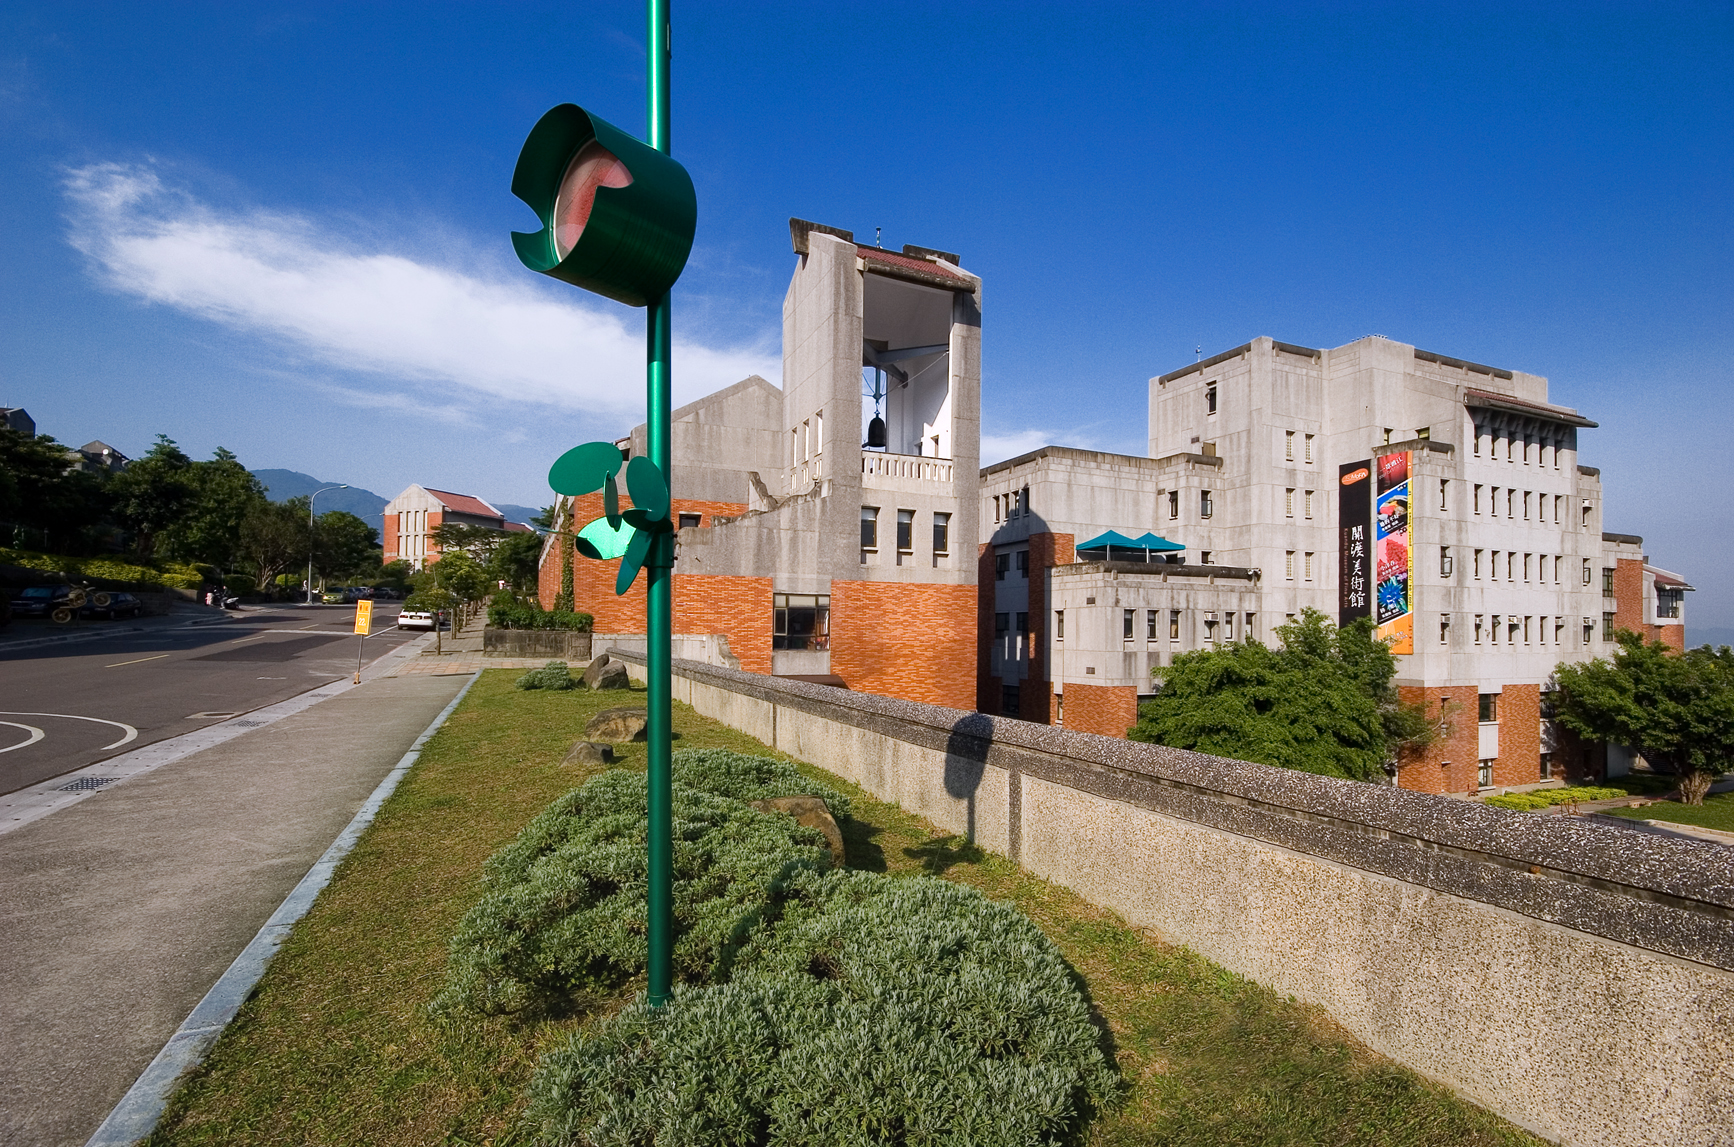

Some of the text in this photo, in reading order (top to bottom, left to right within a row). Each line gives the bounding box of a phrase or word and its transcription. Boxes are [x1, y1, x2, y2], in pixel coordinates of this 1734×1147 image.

[1349, 525, 1366, 608] 關渡美術館
